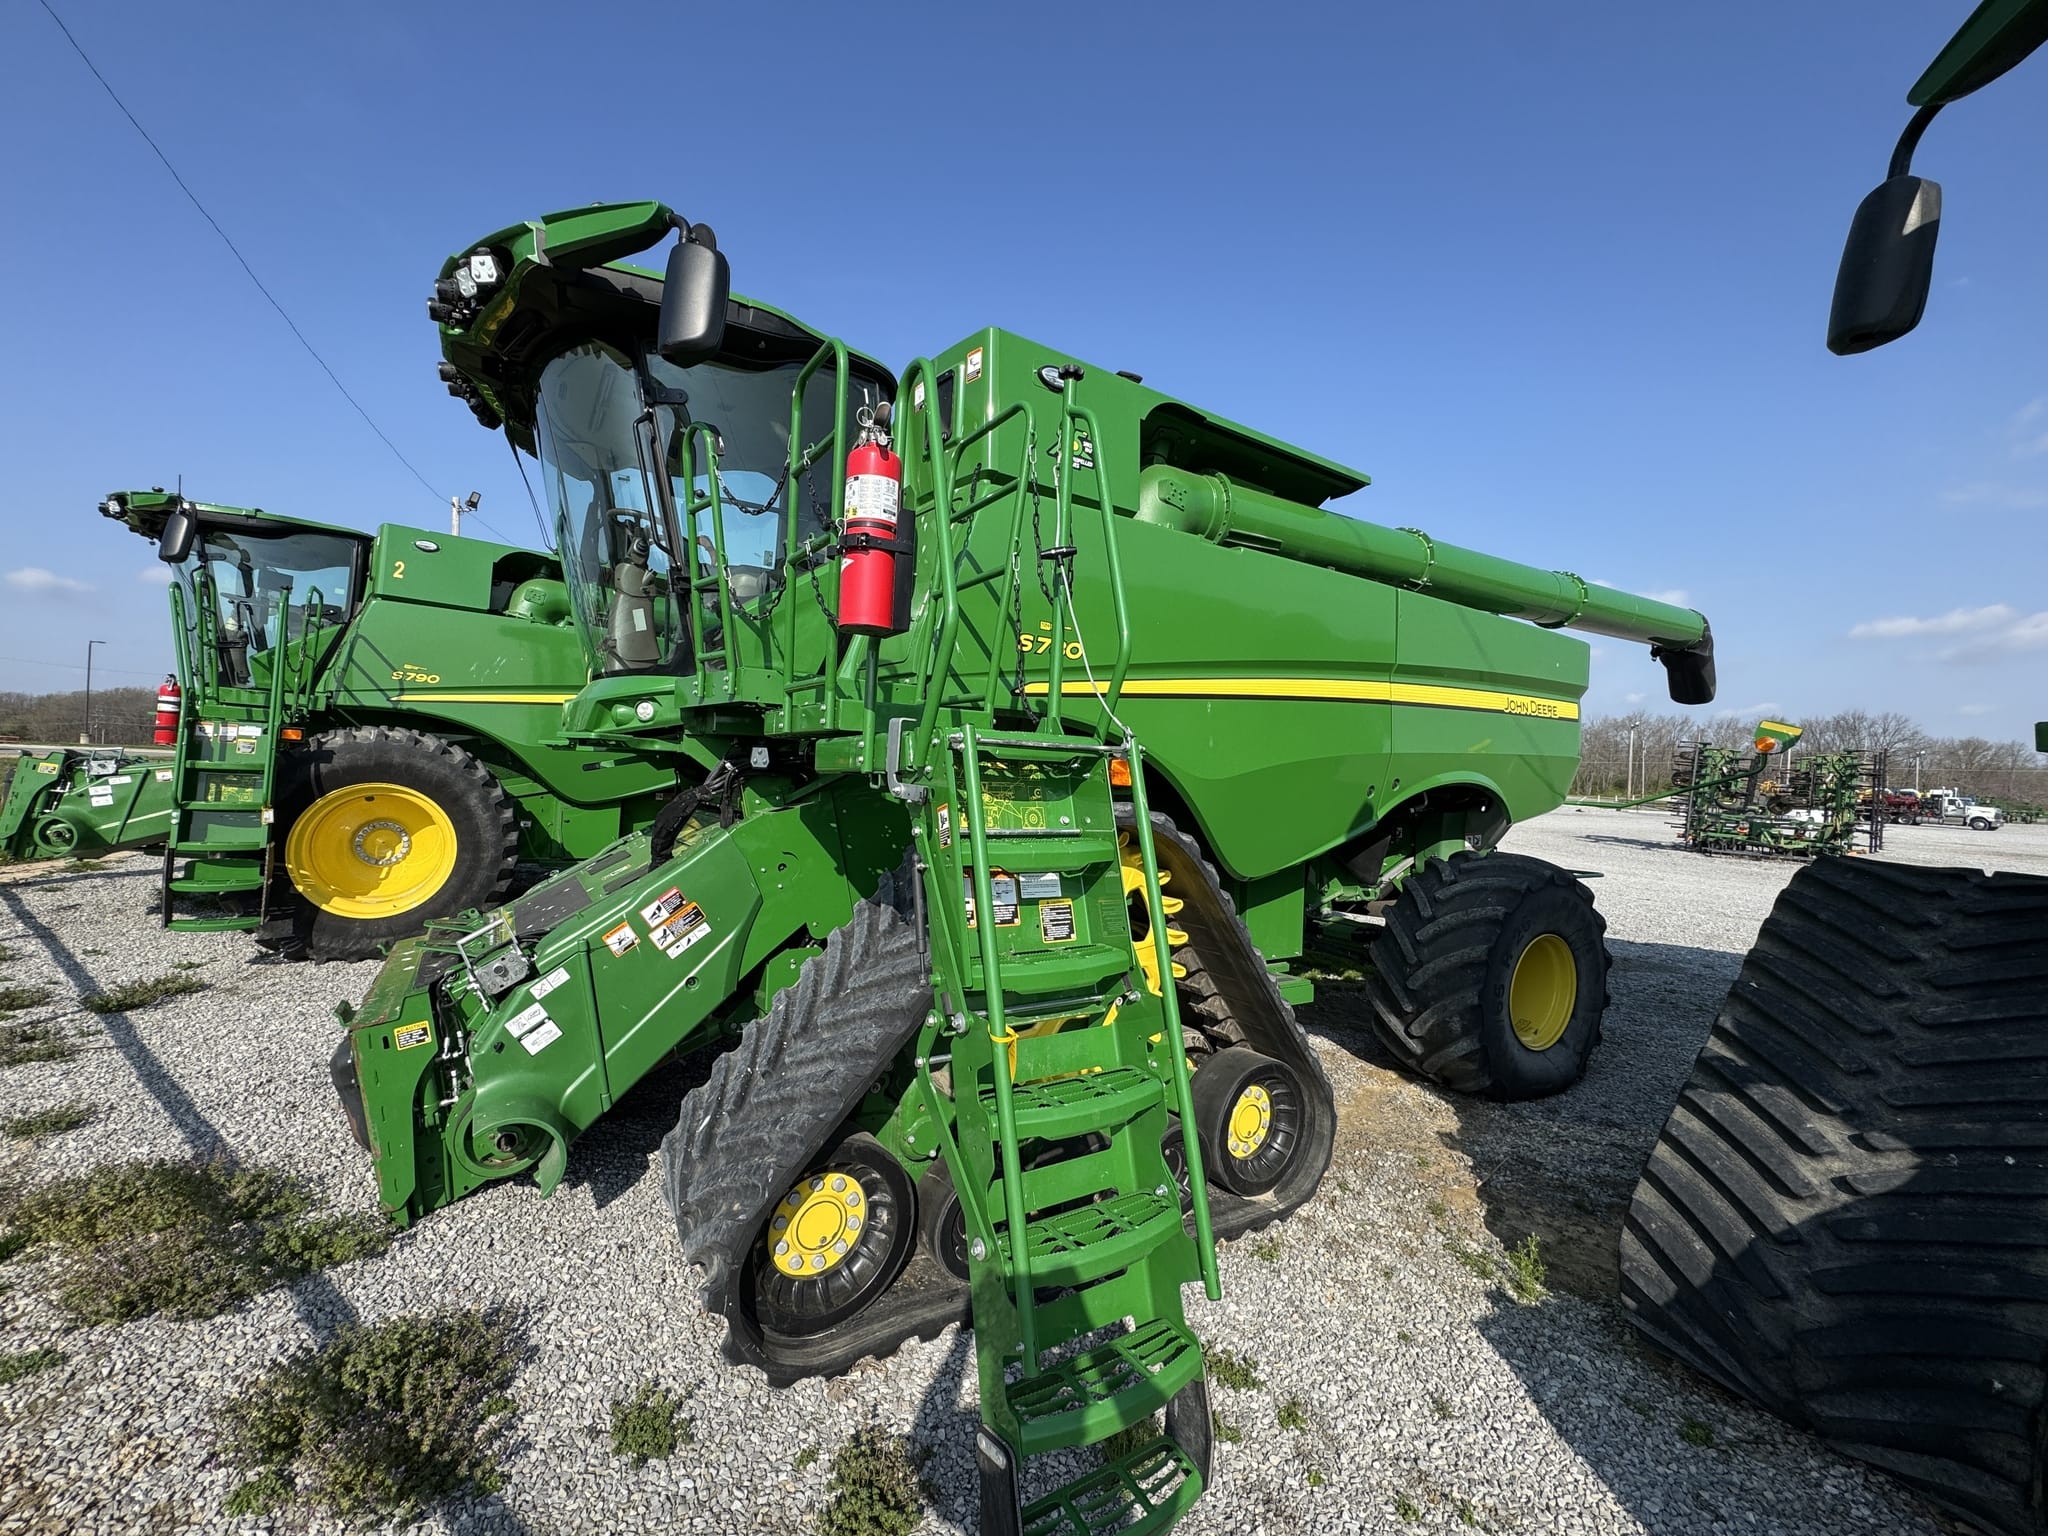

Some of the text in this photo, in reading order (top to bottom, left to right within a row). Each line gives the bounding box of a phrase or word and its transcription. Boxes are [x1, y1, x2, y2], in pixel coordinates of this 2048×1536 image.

[393, 561, 405, 579] 2
[1018, 633, 1083, 660] S70
[391, 671, 440, 684] S790
[1504, 697, 1559, 717] JOHN DEERE
